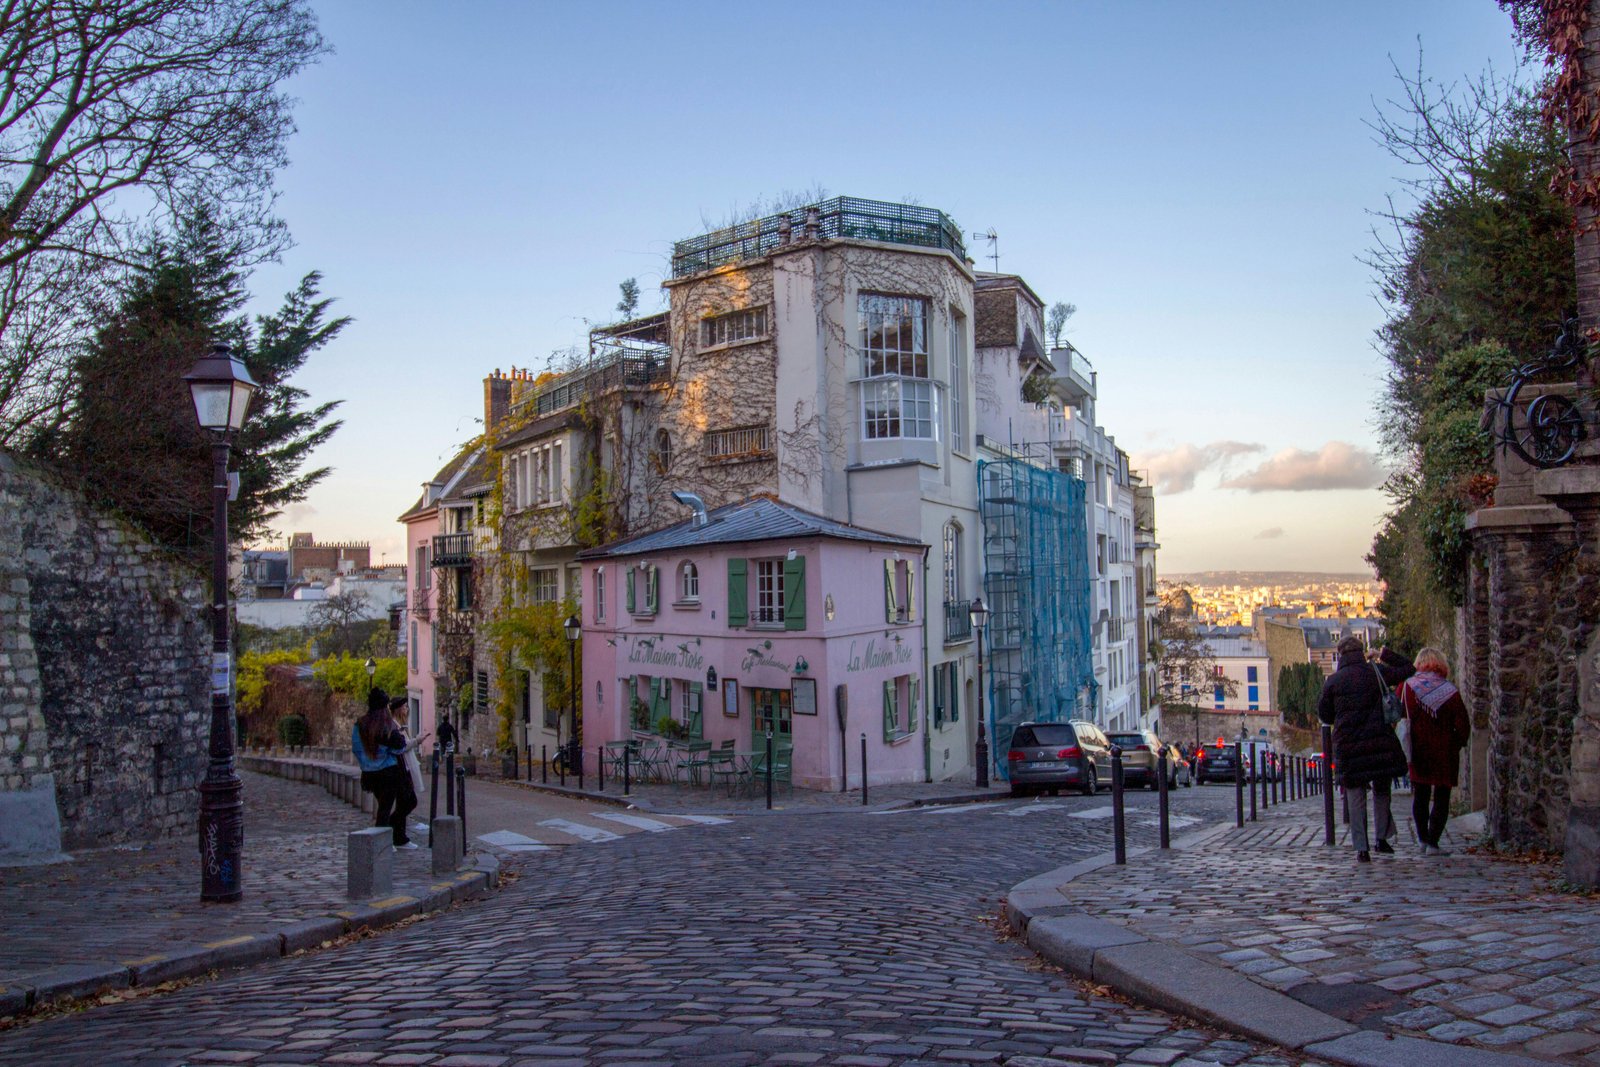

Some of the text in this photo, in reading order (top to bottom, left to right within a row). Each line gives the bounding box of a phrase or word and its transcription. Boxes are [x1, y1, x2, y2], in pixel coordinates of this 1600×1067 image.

[628, 636, 704, 670] La Maison Rose
[847, 640, 860, 672] La
[862, 638, 893, 671] Maison
